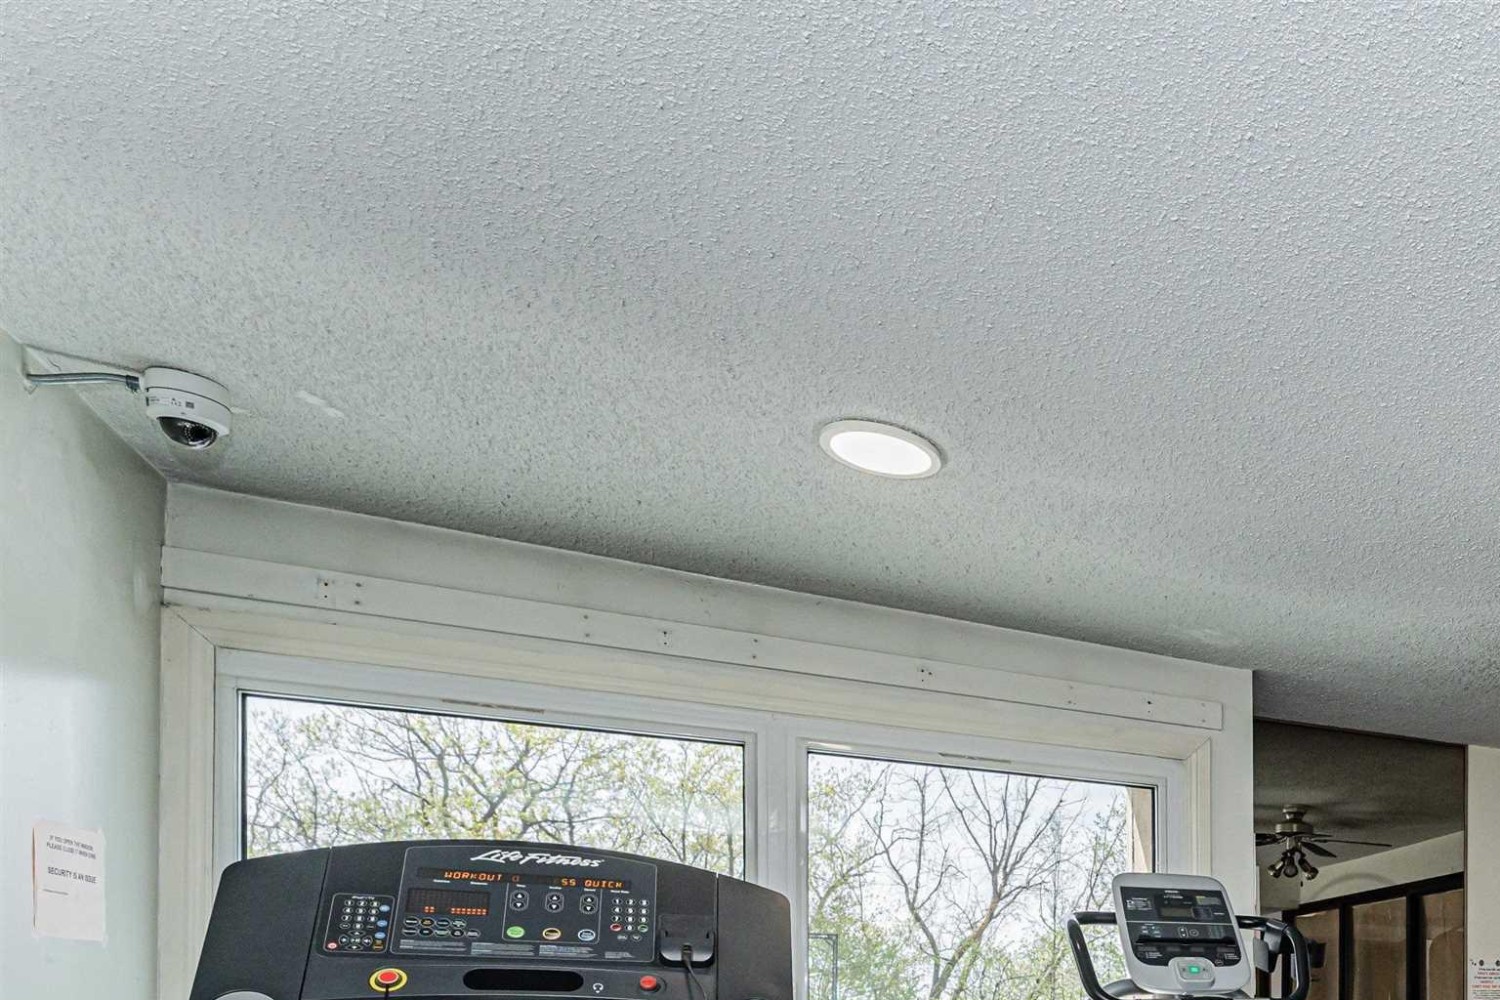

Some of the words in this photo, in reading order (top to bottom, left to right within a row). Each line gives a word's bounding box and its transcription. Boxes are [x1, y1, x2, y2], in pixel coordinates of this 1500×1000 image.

[470, 849, 520, 864] Life
[519, 853, 601, 868] Fitness
[444, 872, 503, 882] WORKOUT
